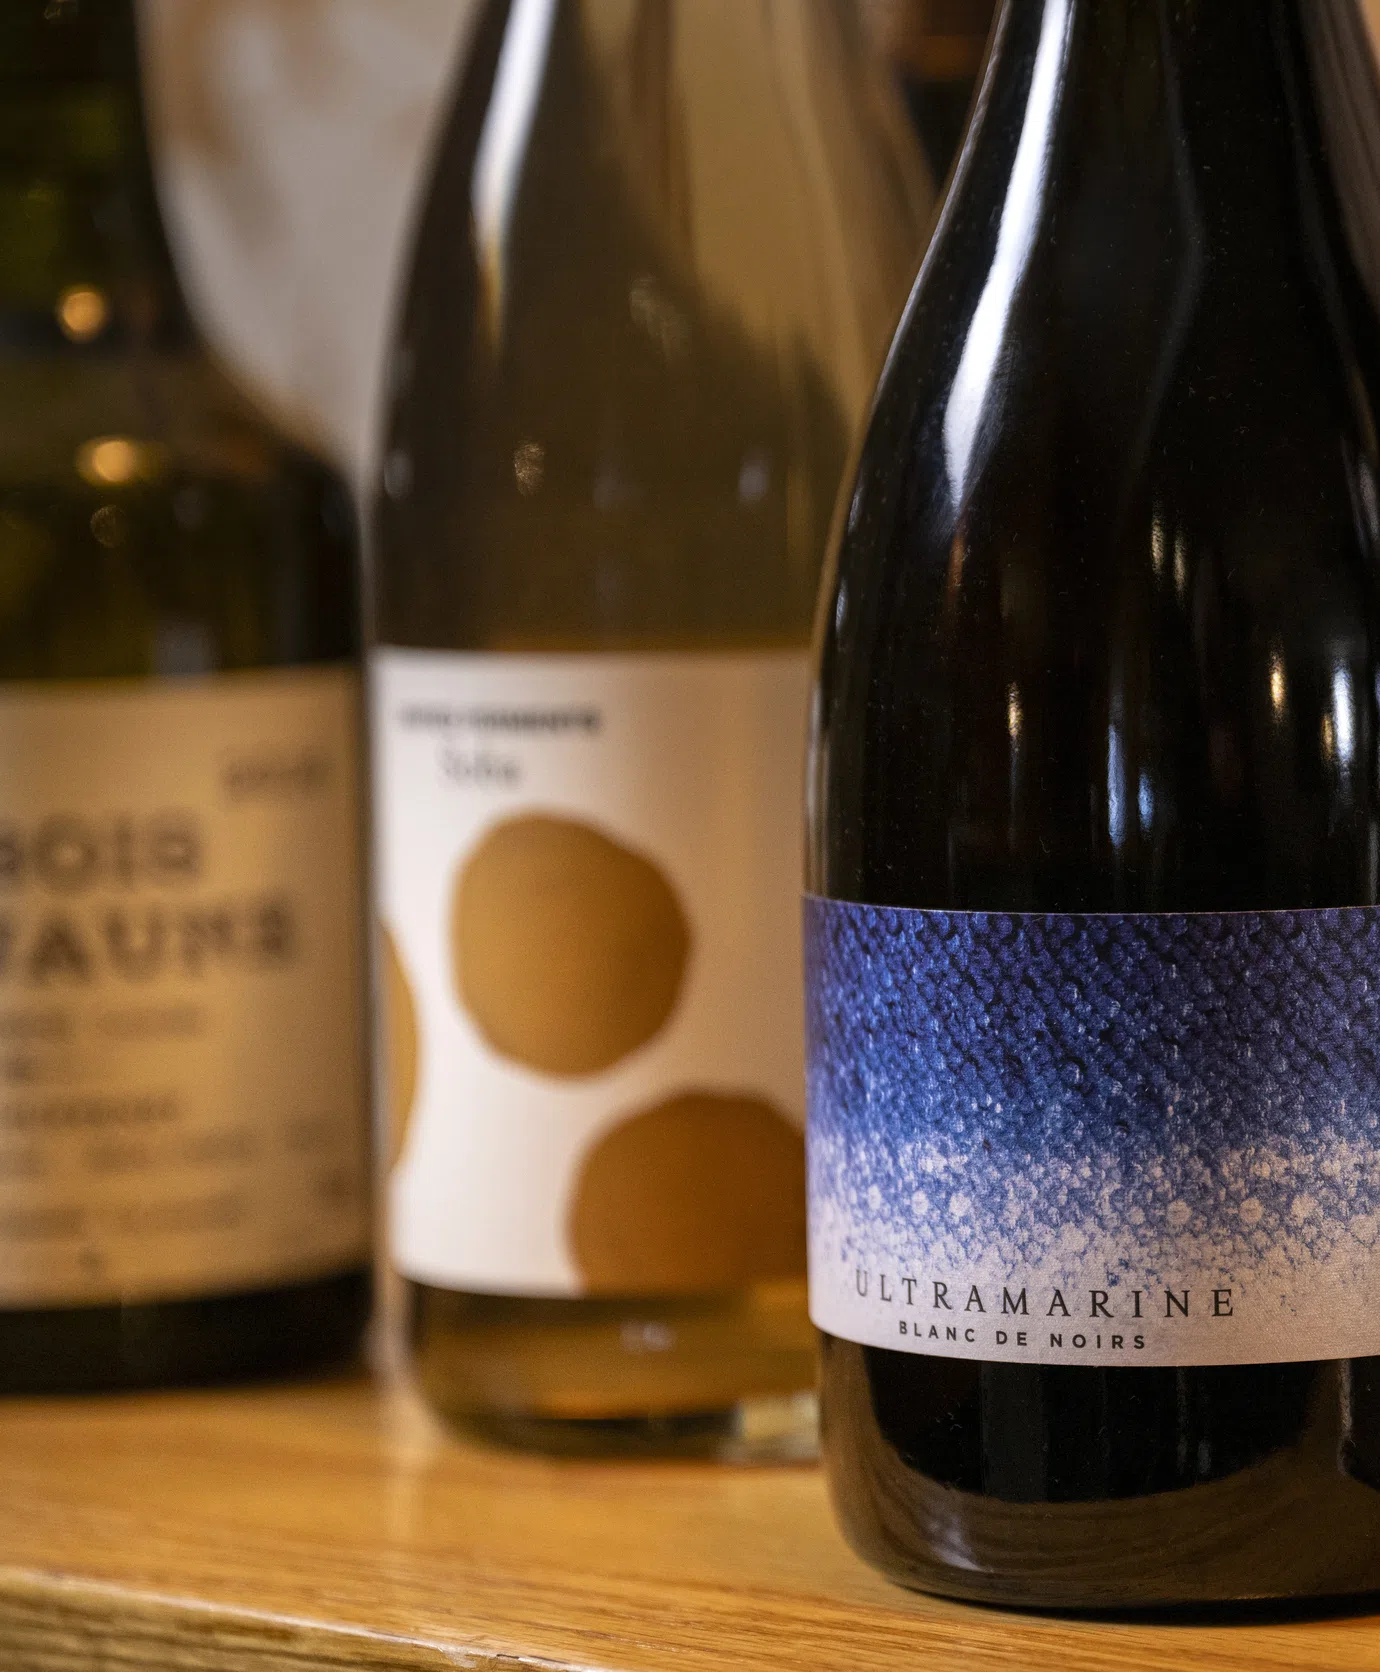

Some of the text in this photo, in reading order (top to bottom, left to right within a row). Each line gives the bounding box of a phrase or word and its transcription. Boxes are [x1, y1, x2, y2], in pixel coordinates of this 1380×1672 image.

[855, 1269, 1235, 1318] ULTRAMARINE
[898, 1320, 1146, 1349] BLANC DE NOIRS
